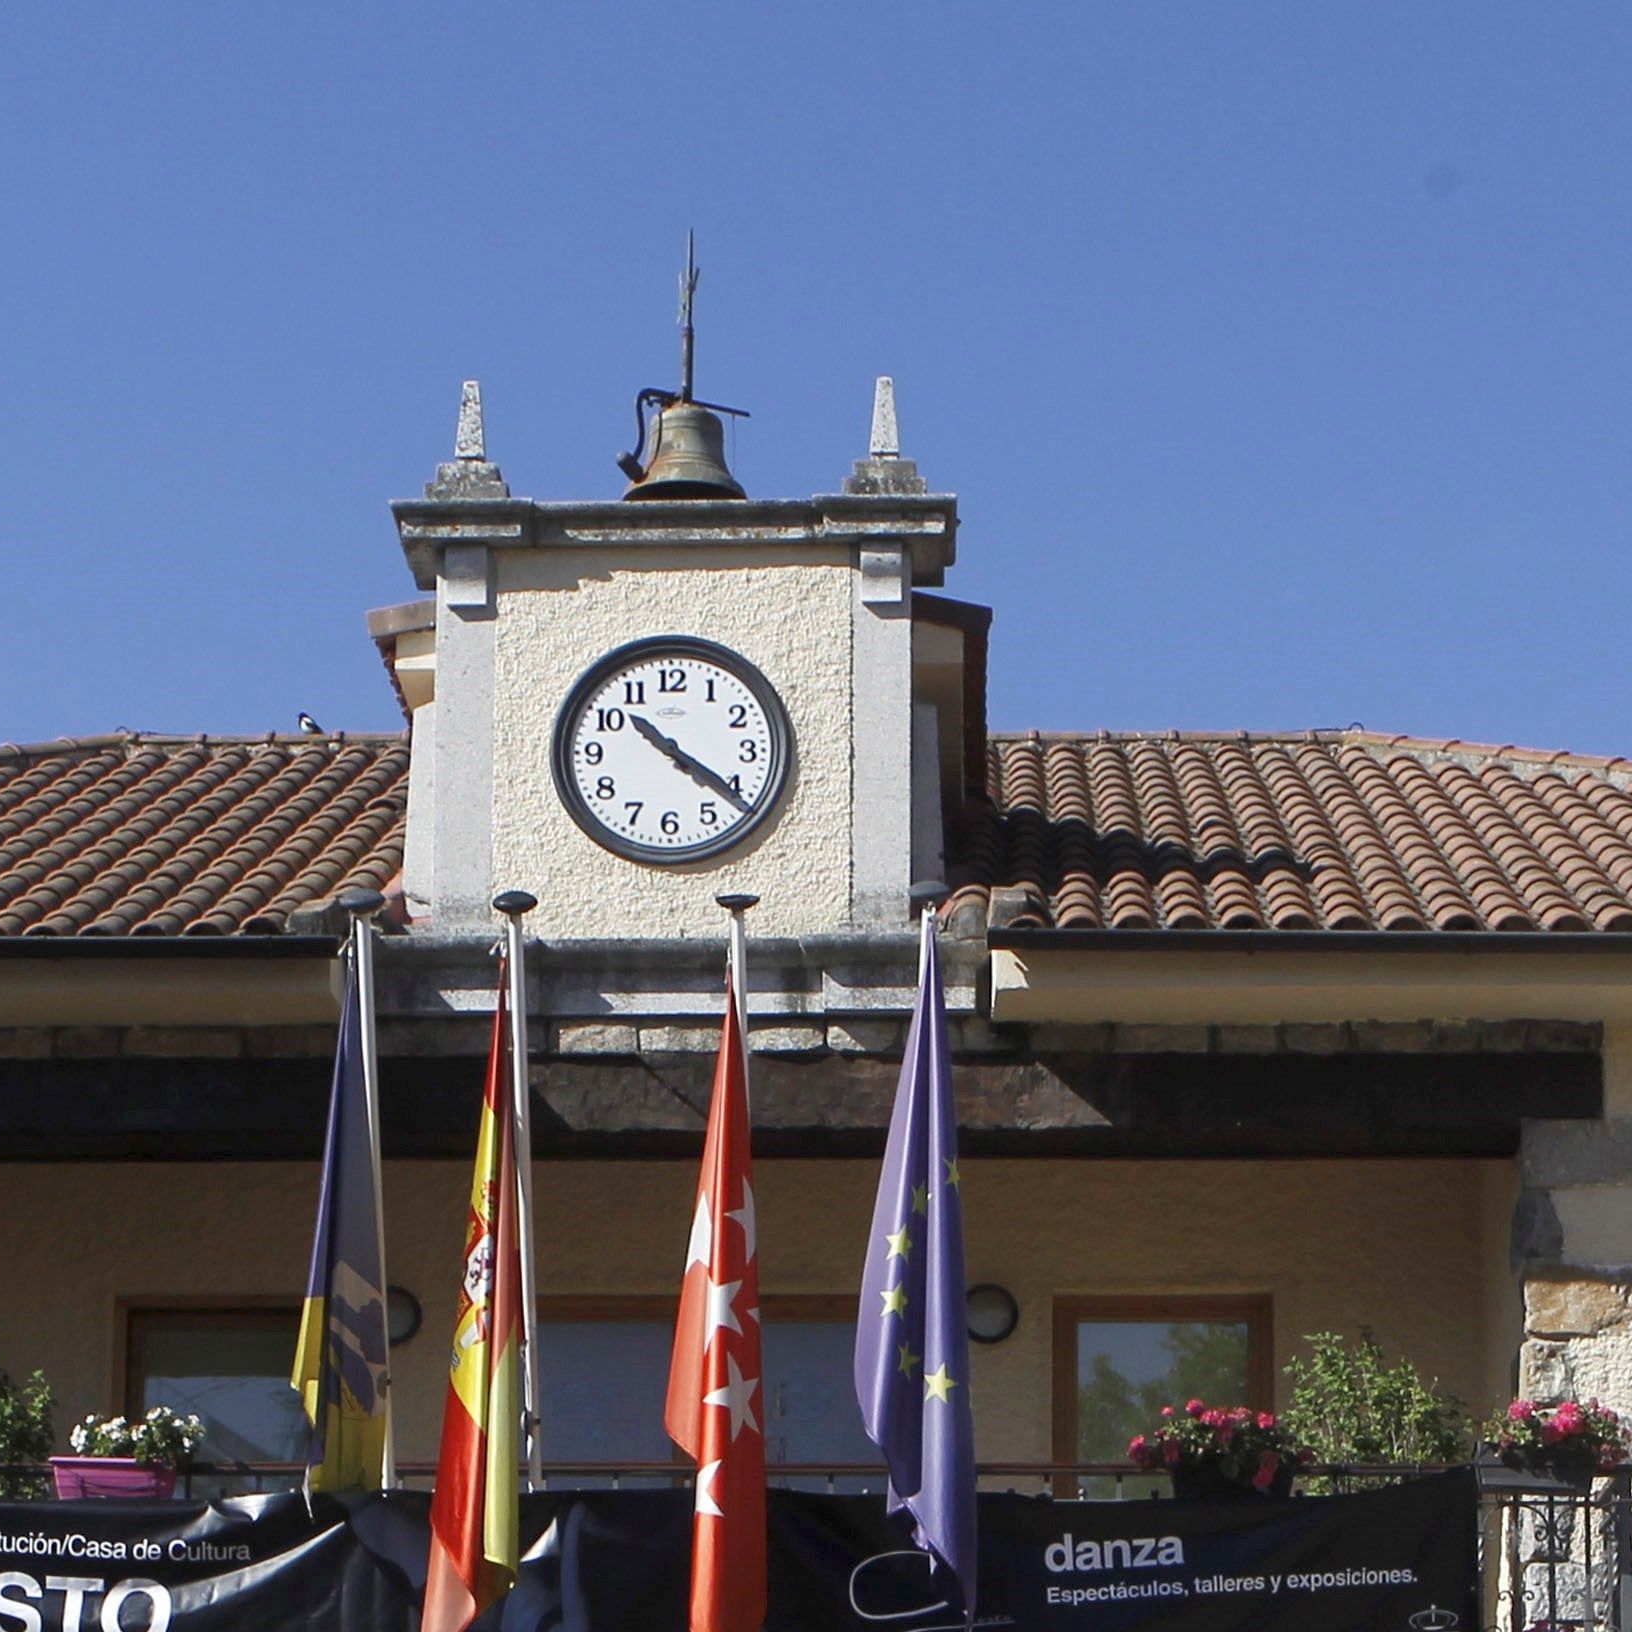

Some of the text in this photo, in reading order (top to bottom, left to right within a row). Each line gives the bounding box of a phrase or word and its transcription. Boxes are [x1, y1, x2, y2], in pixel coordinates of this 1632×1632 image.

[624, 681, 646, 704] 11
[658, 669, 688, 693] 12
[705, 679, 717, 702] 1
[596, 708, 625, 731] 10
[729, 704, 748, 728] 2
[584, 742, 603, 765] 9
[739, 739, 757, 763] 3
[596, 776, 615, 800] 8
[727, 774, 744, 798] 4
[624, 802, 644, 826] 7
[660, 811, 680, 835] 6
[699, 801, 717, 825] 5
[132, 1538, 162, 1561] de
[168, 1539, 251, 1562] Cultura
[1044, 1533, 1184, 1573] danza
[1047, 1567, 1418, 1605] Espectáculos, talleres y exposiciones.
